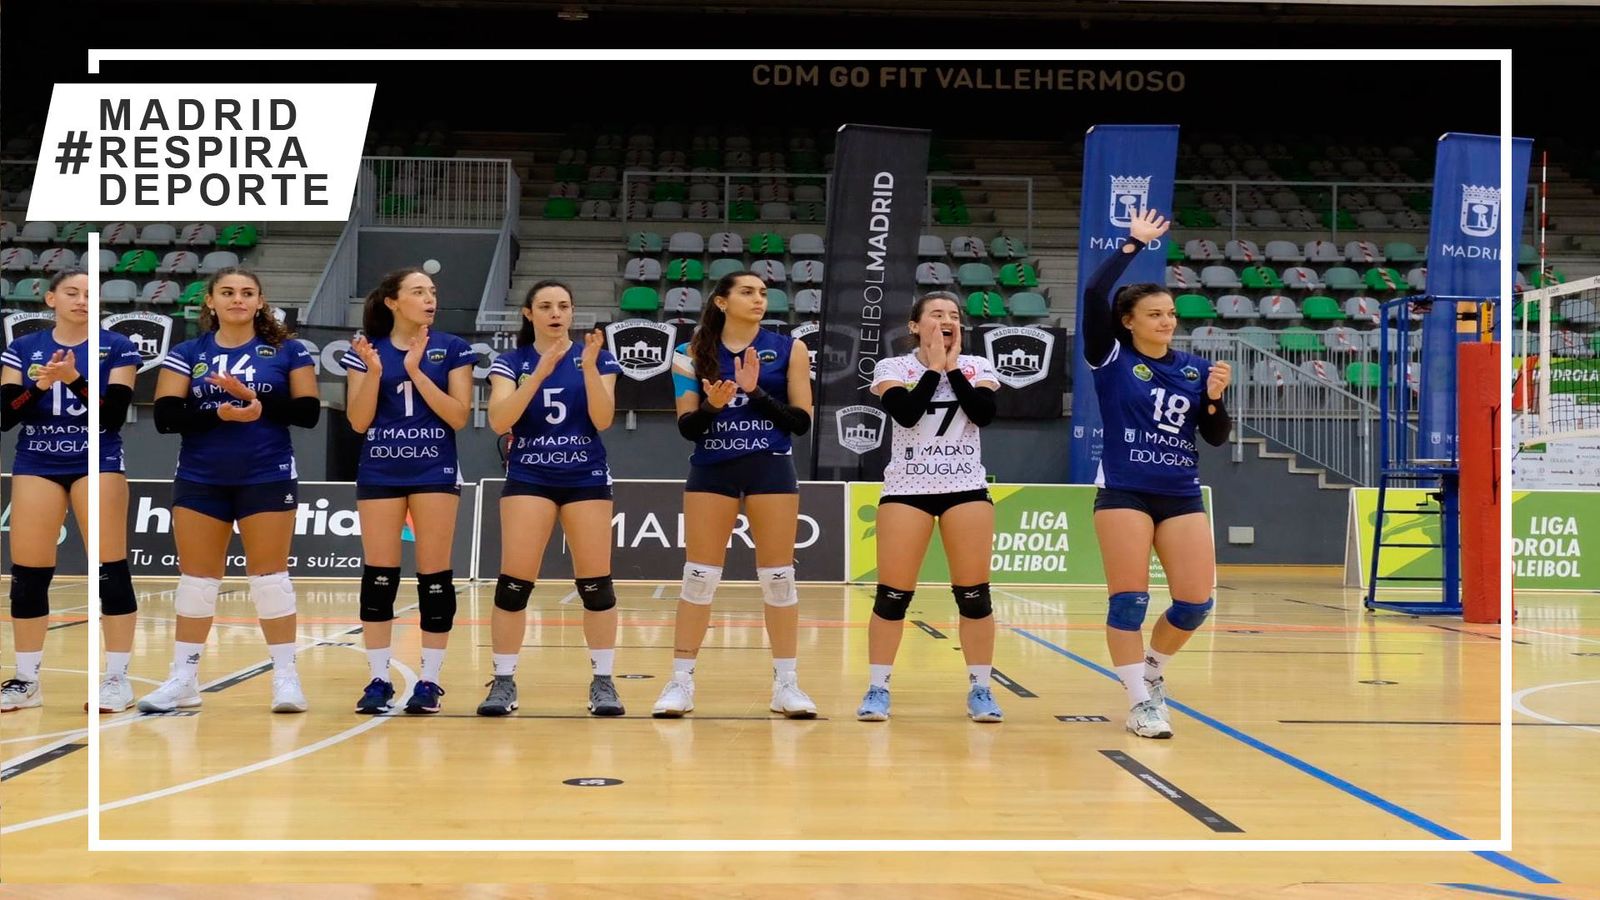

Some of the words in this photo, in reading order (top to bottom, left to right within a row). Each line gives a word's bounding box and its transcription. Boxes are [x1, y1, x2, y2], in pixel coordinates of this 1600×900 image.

[752, 64, 819, 87] CDM
[829, 66, 870, 89] GO
[880, 67, 927, 89] FIT
[936, 67, 1186, 92] VALLEHERMOSO
[1090, 236, 1161, 251] MADD
[1442, 243, 1501, 260] MADRI
[993, 328, 1019, 339] MADRID
[1020, 328, 1045, 339] CIUDAD
[212, 353, 256, 381] 14
[397, 380, 414, 417] 1
[543, 387, 567, 425] 5
[1150, 387, 1191, 428] 18
[717, 419, 774, 432] MADRID
[926, 401, 960, 437] 7
[383, 428, 446, 439] MADRID
[533, 435, 591, 446] MADRID
[28, 440, 89, 452] DOUGLA
[370, 445, 439, 458] DOUGLAS
[704, 438, 769, 450] DOUGLAS
[921, 445, 975, 456] MADRID
[520, 450, 588, 465] DOUGLAS
[905, 463, 972, 475] DOUGLAS
[1020, 511, 1068, 530] LIGA
[1530, 516, 1578, 535] LIGA
[131, 549, 152, 566] Tu
[306, 552, 361, 568] suiza
[990, 554, 1067, 572] OLEIBOL
[1512, 560, 1581, 577] LEIBOL
